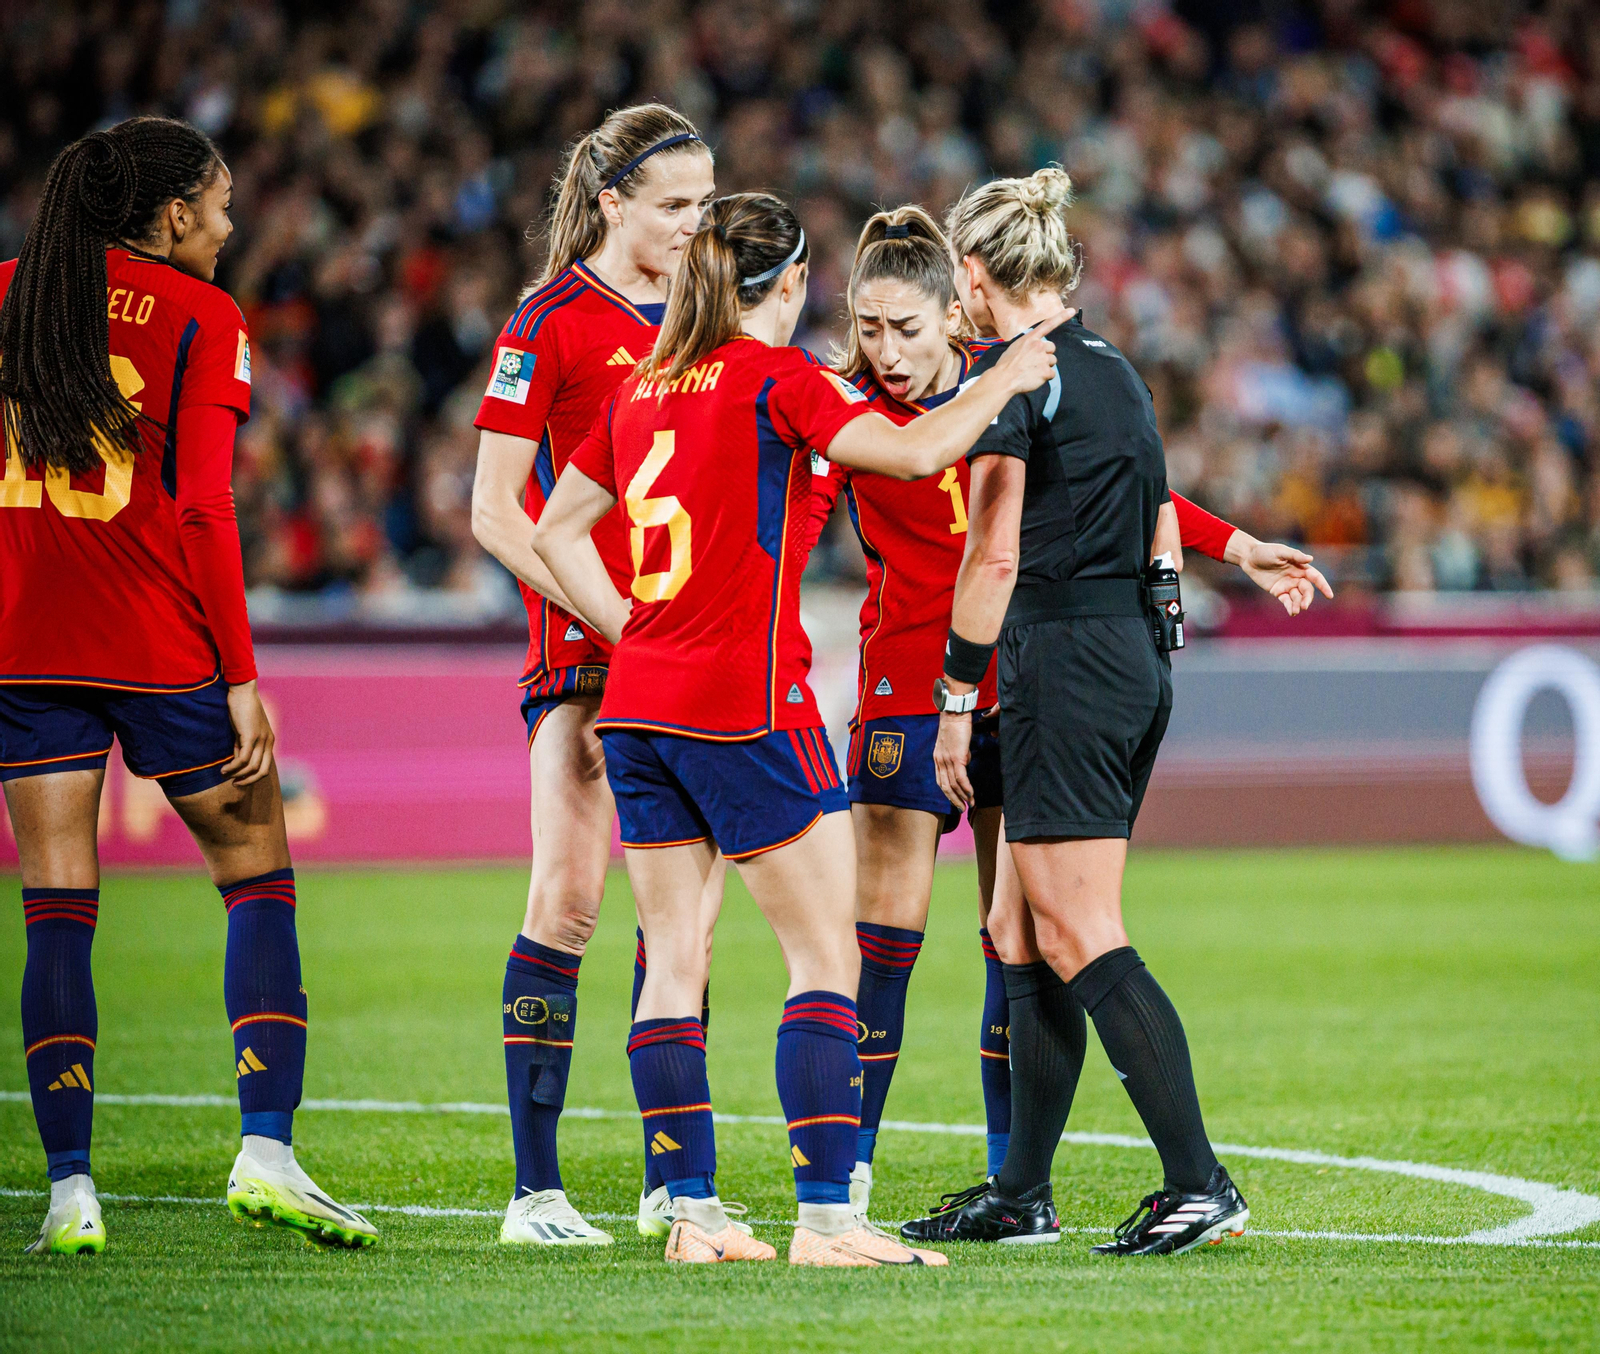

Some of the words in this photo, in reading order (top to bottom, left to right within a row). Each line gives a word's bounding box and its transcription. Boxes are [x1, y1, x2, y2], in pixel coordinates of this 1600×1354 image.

[107, 286, 155, 325] ELO
[624, 429, 693, 603] 6
[871, 1030, 887, 1039] 09
[990, 1024, 1003, 1035] 19
[849, 1076, 861, 1088] 19
